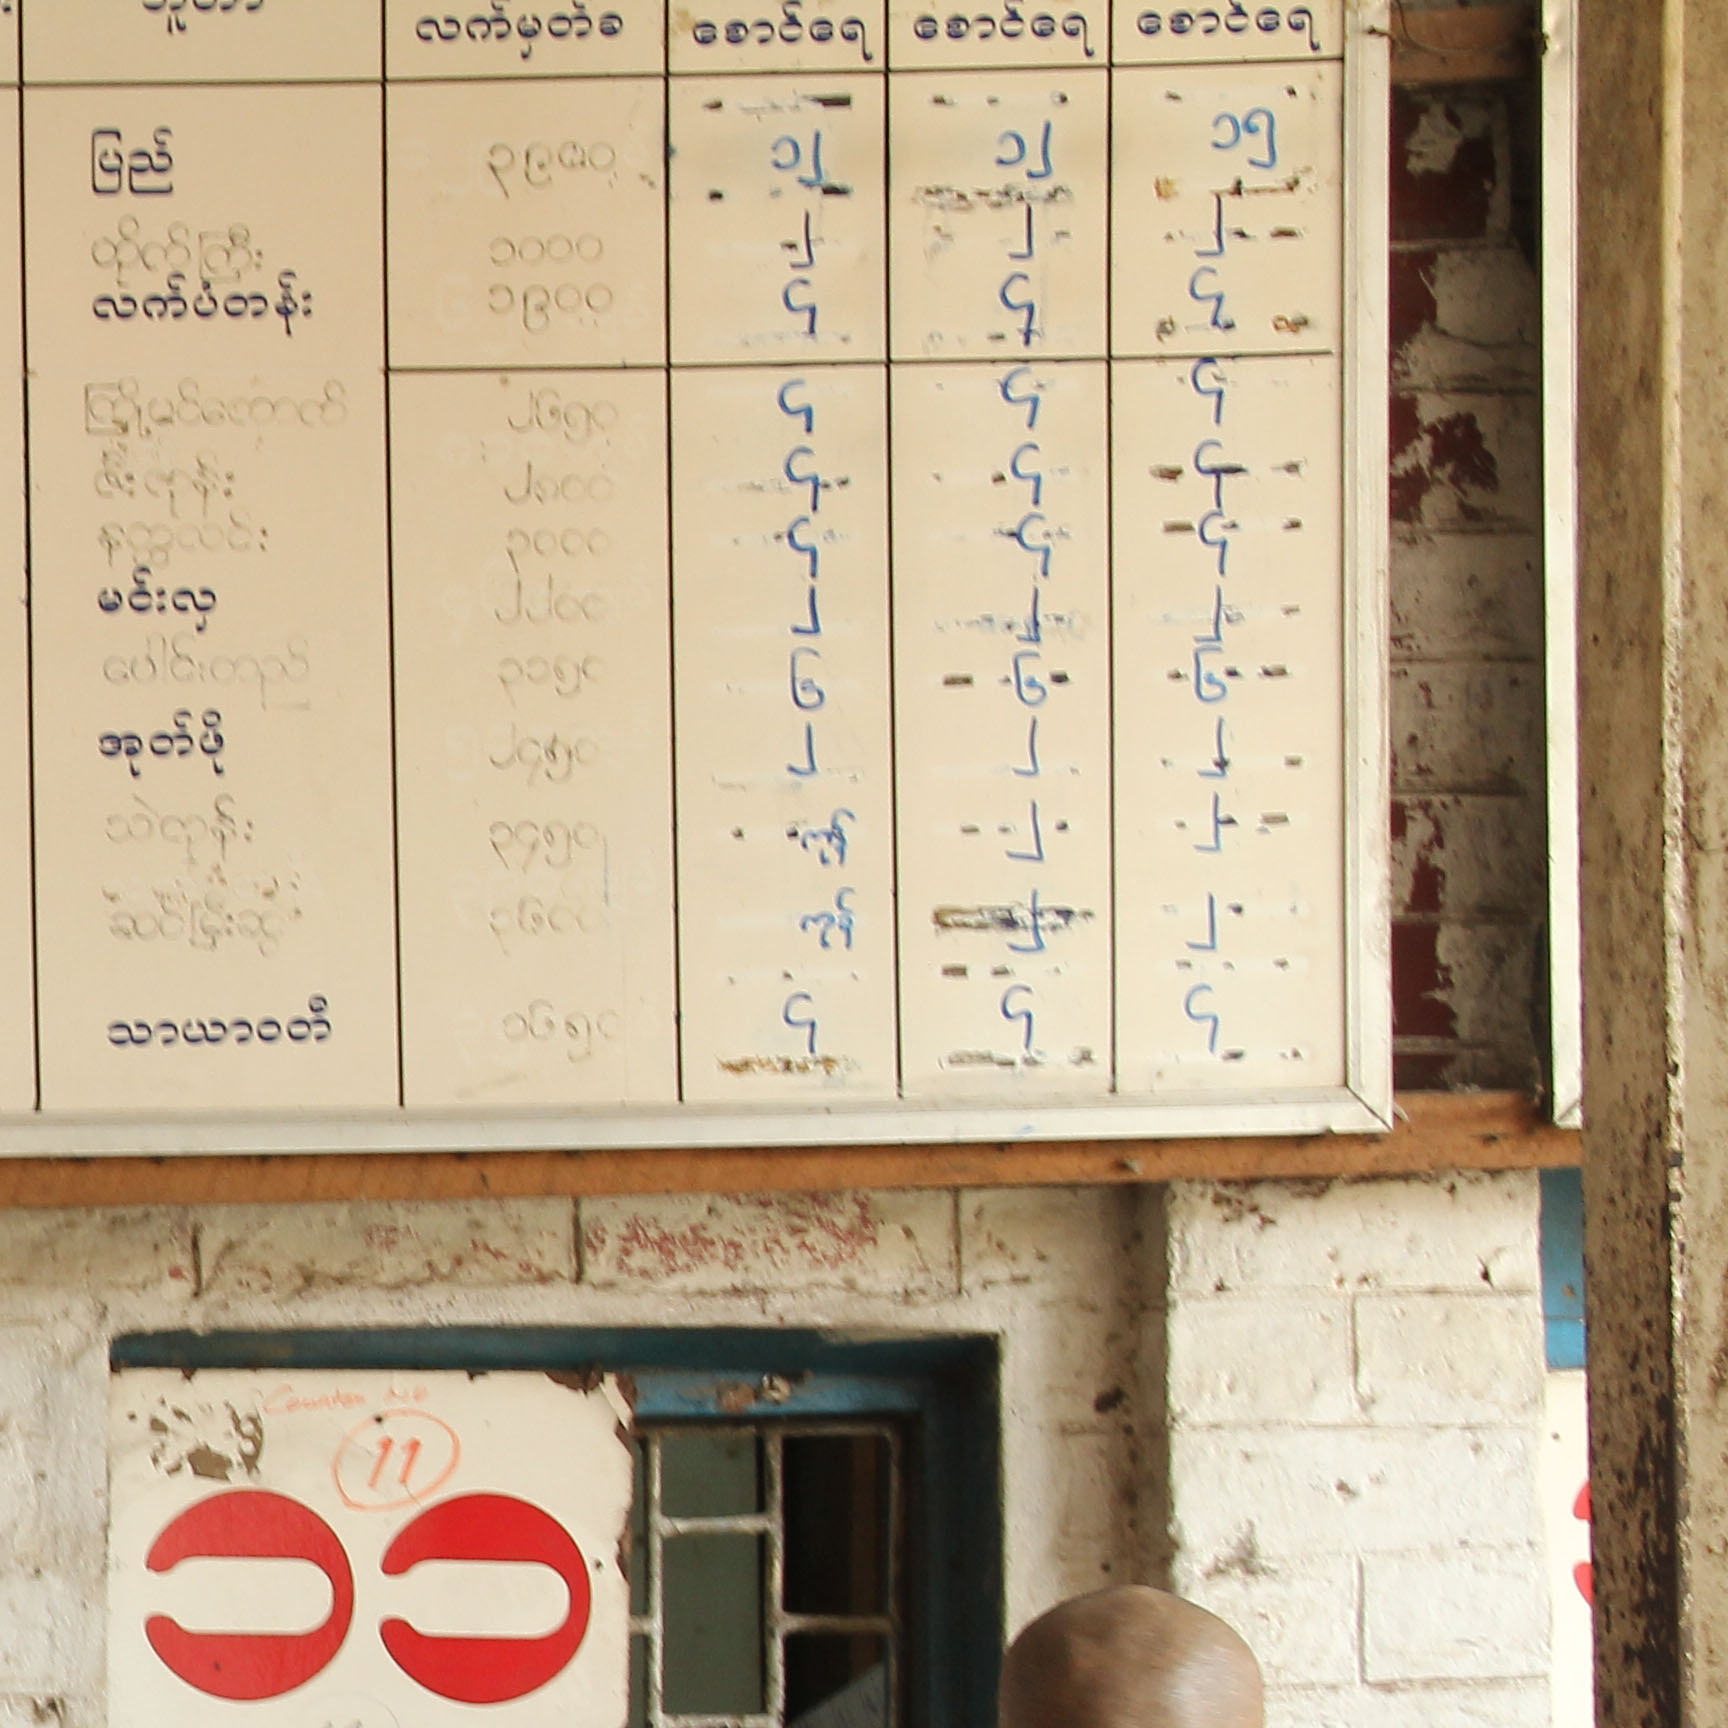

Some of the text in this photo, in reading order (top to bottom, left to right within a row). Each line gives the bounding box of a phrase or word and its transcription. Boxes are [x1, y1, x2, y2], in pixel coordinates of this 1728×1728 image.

[91, 127, 173, 194] ပြည်
[367, 1435, 423, 1490] 11
[144, 1489, 591, 1704] ၁၁
